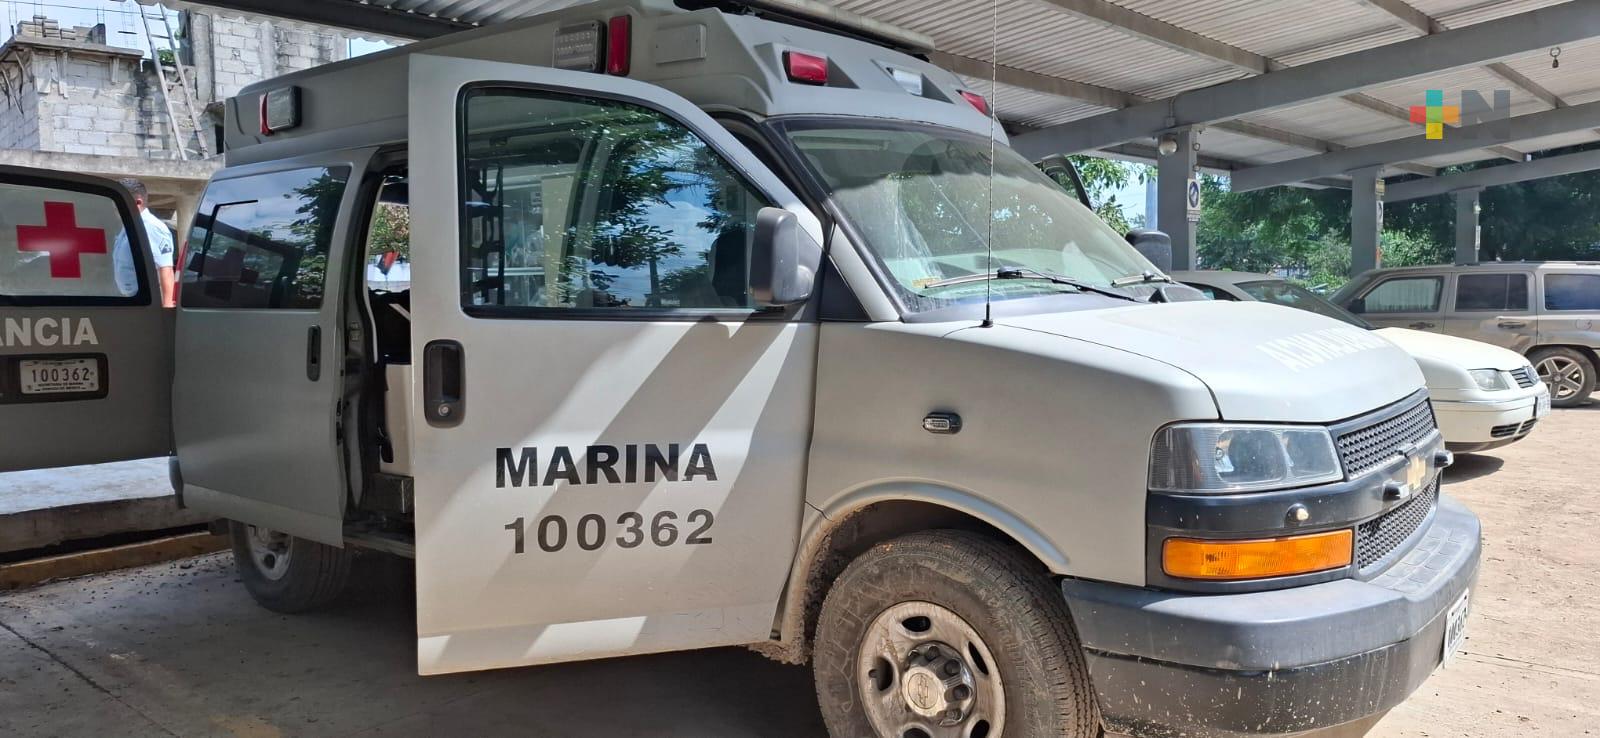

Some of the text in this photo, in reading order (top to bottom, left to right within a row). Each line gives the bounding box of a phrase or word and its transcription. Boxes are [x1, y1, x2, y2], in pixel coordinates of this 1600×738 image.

[0, 317, 98, 346] NCIA
[32, 367, 90, 382] 100362
[495, 443, 718, 488] MARINA
[504, 509, 714, 553] 100362
